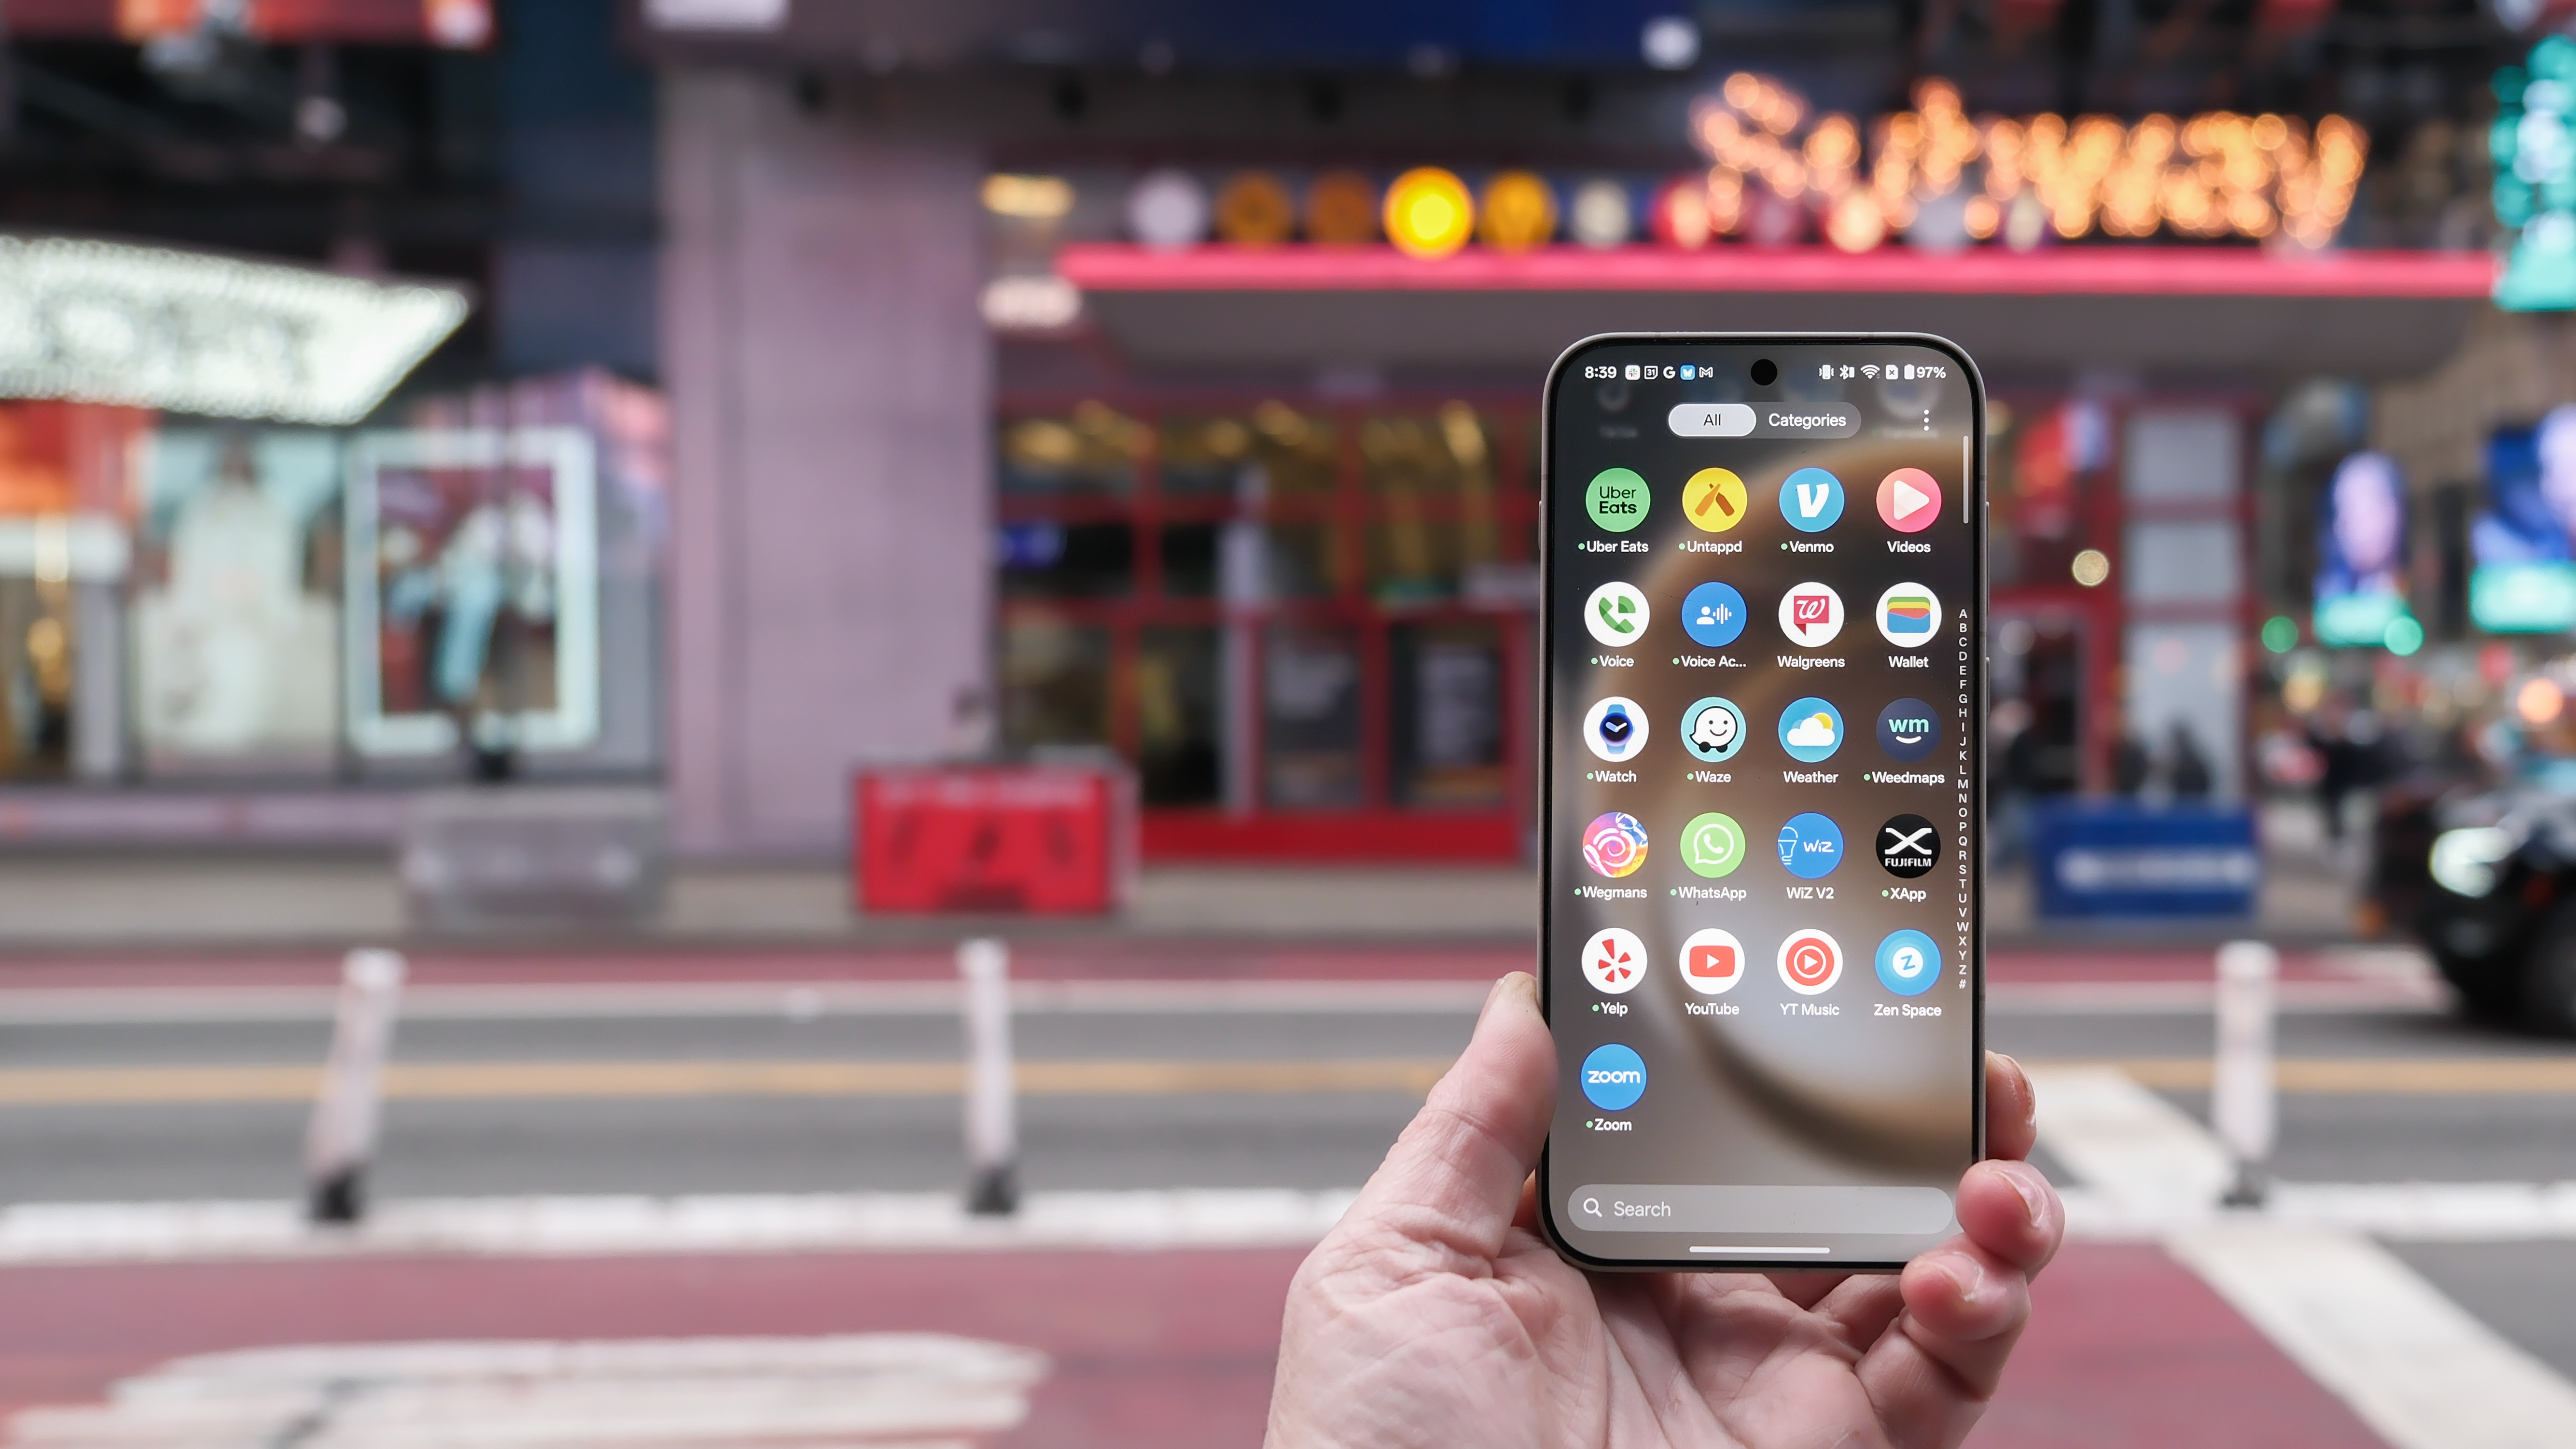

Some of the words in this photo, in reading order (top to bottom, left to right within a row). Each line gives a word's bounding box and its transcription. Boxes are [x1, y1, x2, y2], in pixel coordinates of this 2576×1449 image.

[1585, 366, 1617, 379] 8:39
[1647, 368, 1656, 377] 31
[1663, 366, 1676, 379] G
[1916, 366, 1947, 378] 97%
[1703, 414, 1721, 426] All
[1768, 413, 1847, 430] Categories
[1600, 486, 1636, 499] Uber
[1599, 501, 1637, 514] Eats
[1587, 540, 1618, 552] Uber
[1621, 540, 1649, 552] Eats
[1687, 540, 1742, 555] Untappd
[1789, 541, 1834, 553] Venmo
[1887, 541, 1931, 553] Videos
[1959, 609, 1968, 618] A
[1960, 623, 1967, 633] B
[1959, 637, 1967, 647] C
[1599, 655, 1634, 667] Voice
[1681, 655, 1716, 667] Voice
[1888, 655, 1929, 668] Wallet
[1959, 651, 1967, 661] D
[1777, 655, 1845, 670] Walgreens
[1960, 665, 1967, 675] E
[1960, 680, 1967, 689] F
[1959, 694, 1968, 704] G
[1959, 708, 1967, 718] H
[1888, 719, 1929, 733] wm
[1960, 736, 1966, 746] J
[1959, 751, 1967, 761] K
[1595, 770, 1637, 782] Watch
[1960, 765, 1966, 775] L
[1695, 770, 1731, 783] Waze
[1783, 771, 1839, 783] Weather
[1872, 771, 1945, 786] Weedmaps
[1958, 779, 1968, 789] M
[1959, 793, 1967, 803] N
[1958, 808, 1968, 818] O
[1959, 822, 1967, 832] P
[1803, 839, 1835, 852] WiZ
[1958, 836, 1968, 846] Q
[1959, 850, 1967, 860] R
[1885, 858, 1932, 867] FUJIFILM
[1959, 864, 1967, 875] S
[1959, 878, 1967, 889] T
[1582, 886, 1647, 901] Wegmans
[1678, 886, 1747, 901] WhatsApp
[1786, 887, 1813, 899] WiZ
[1816, 887, 1834, 899] V2
[1890, 887, 1926, 903] XApp
[1958, 893, 1967, 903] U
[1958, 907, 1967, 918] V
[1956, 921, 1969, 932] W
[1959, 936, 1967, 946] X
[1959, 950, 1967, 961] Y
[1959, 964, 1967, 975] Z
[1959, 979, 1966, 989] #
[1601, 1002, 1628, 1017] Yelp
[1685, 1003, 1740, 1016] YouTube
[1780, 1003, 1798, 1015] YT
[1801, 1003, 1839, 1016] Music
[1874, 1003, 1899, 1016] Zen
[1902, 1003, 1942, 1019] Space
[1587, 1071, 1641, 1084] zoom
[1594, 1118, 1632, 1131] Zoom
[1614, 1201, 1671, 1217] Search
